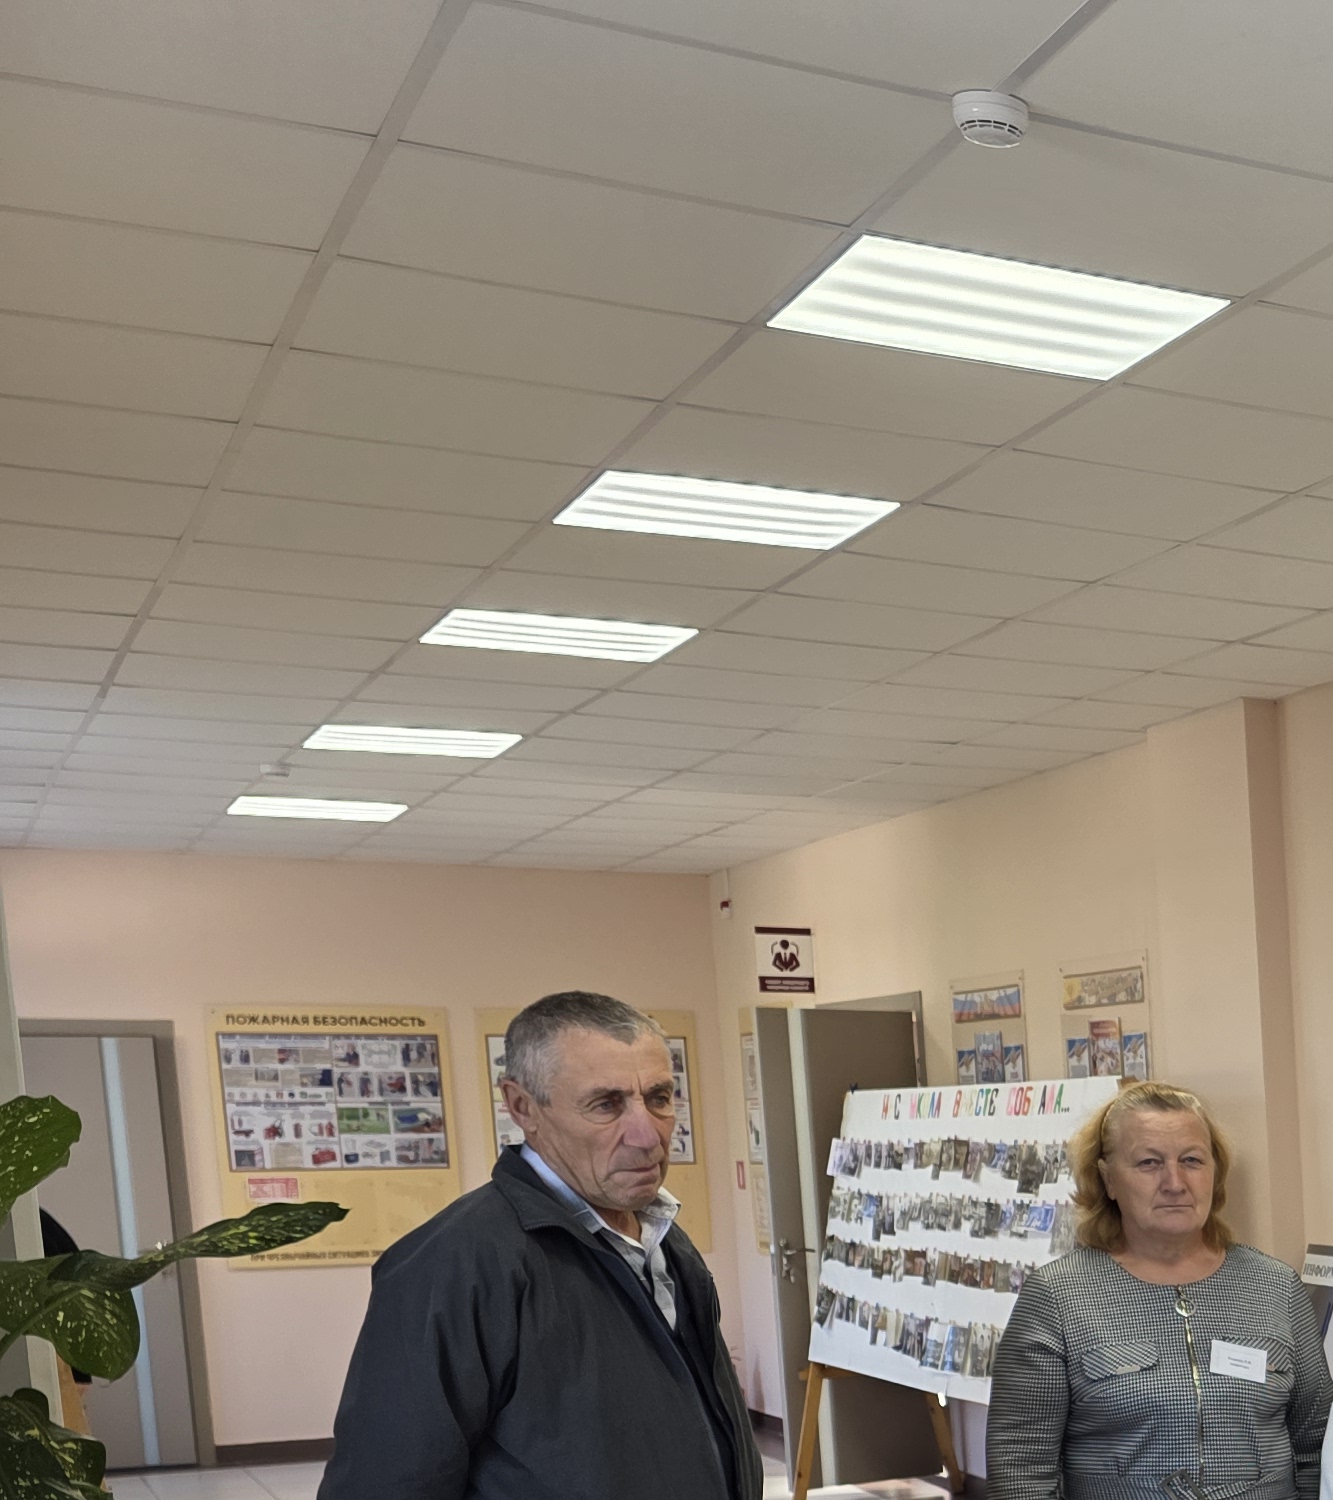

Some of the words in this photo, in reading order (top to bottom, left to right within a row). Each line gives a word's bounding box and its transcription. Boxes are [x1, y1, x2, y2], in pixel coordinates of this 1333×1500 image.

[226, 1015, 310, 1026] ПОЖАРНАЯ
[313, 1016, 426, 1027] БЕЗОПАСНОСТЬ
[882, 1094, 902, 1120] НС
[952, 1088, 999, 1118] ВЕСТЕ
[1006, 1083, 1070, 1117] СОБАЛА...
